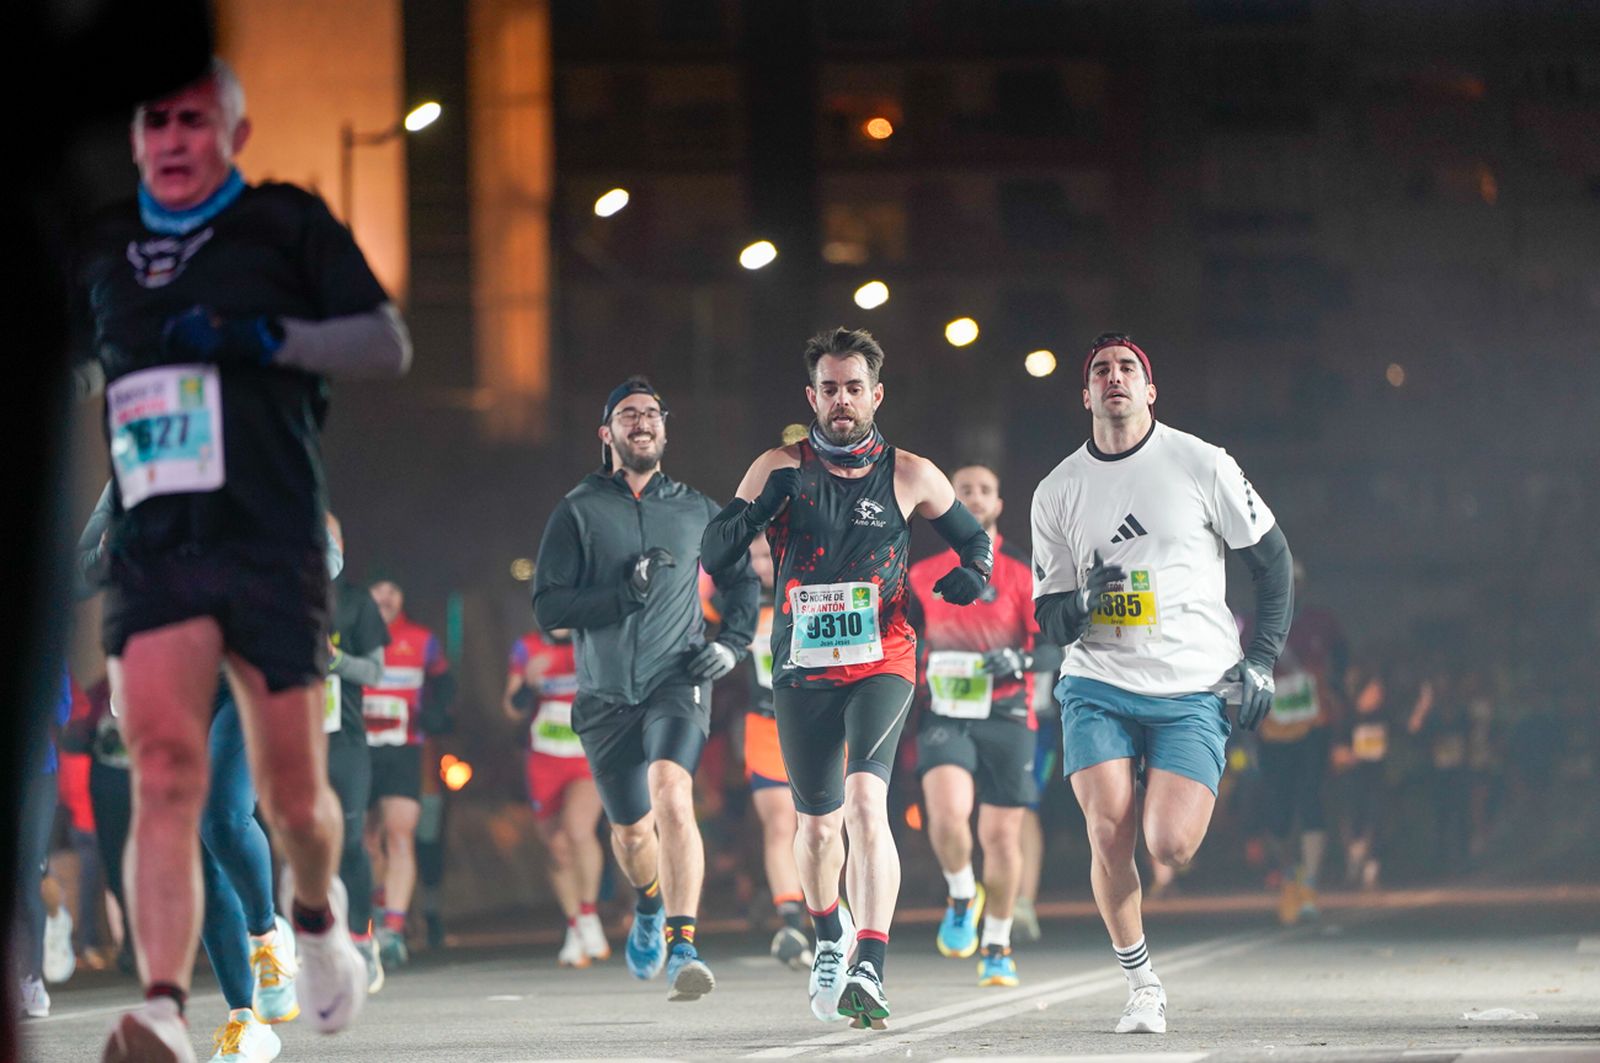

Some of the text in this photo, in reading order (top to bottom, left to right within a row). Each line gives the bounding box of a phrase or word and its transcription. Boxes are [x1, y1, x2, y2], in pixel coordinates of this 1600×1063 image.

[809, 593, 833, 602] NOCHE
[833, 592, 844, 601] DE
[807, 612, 862, 639] 9310
